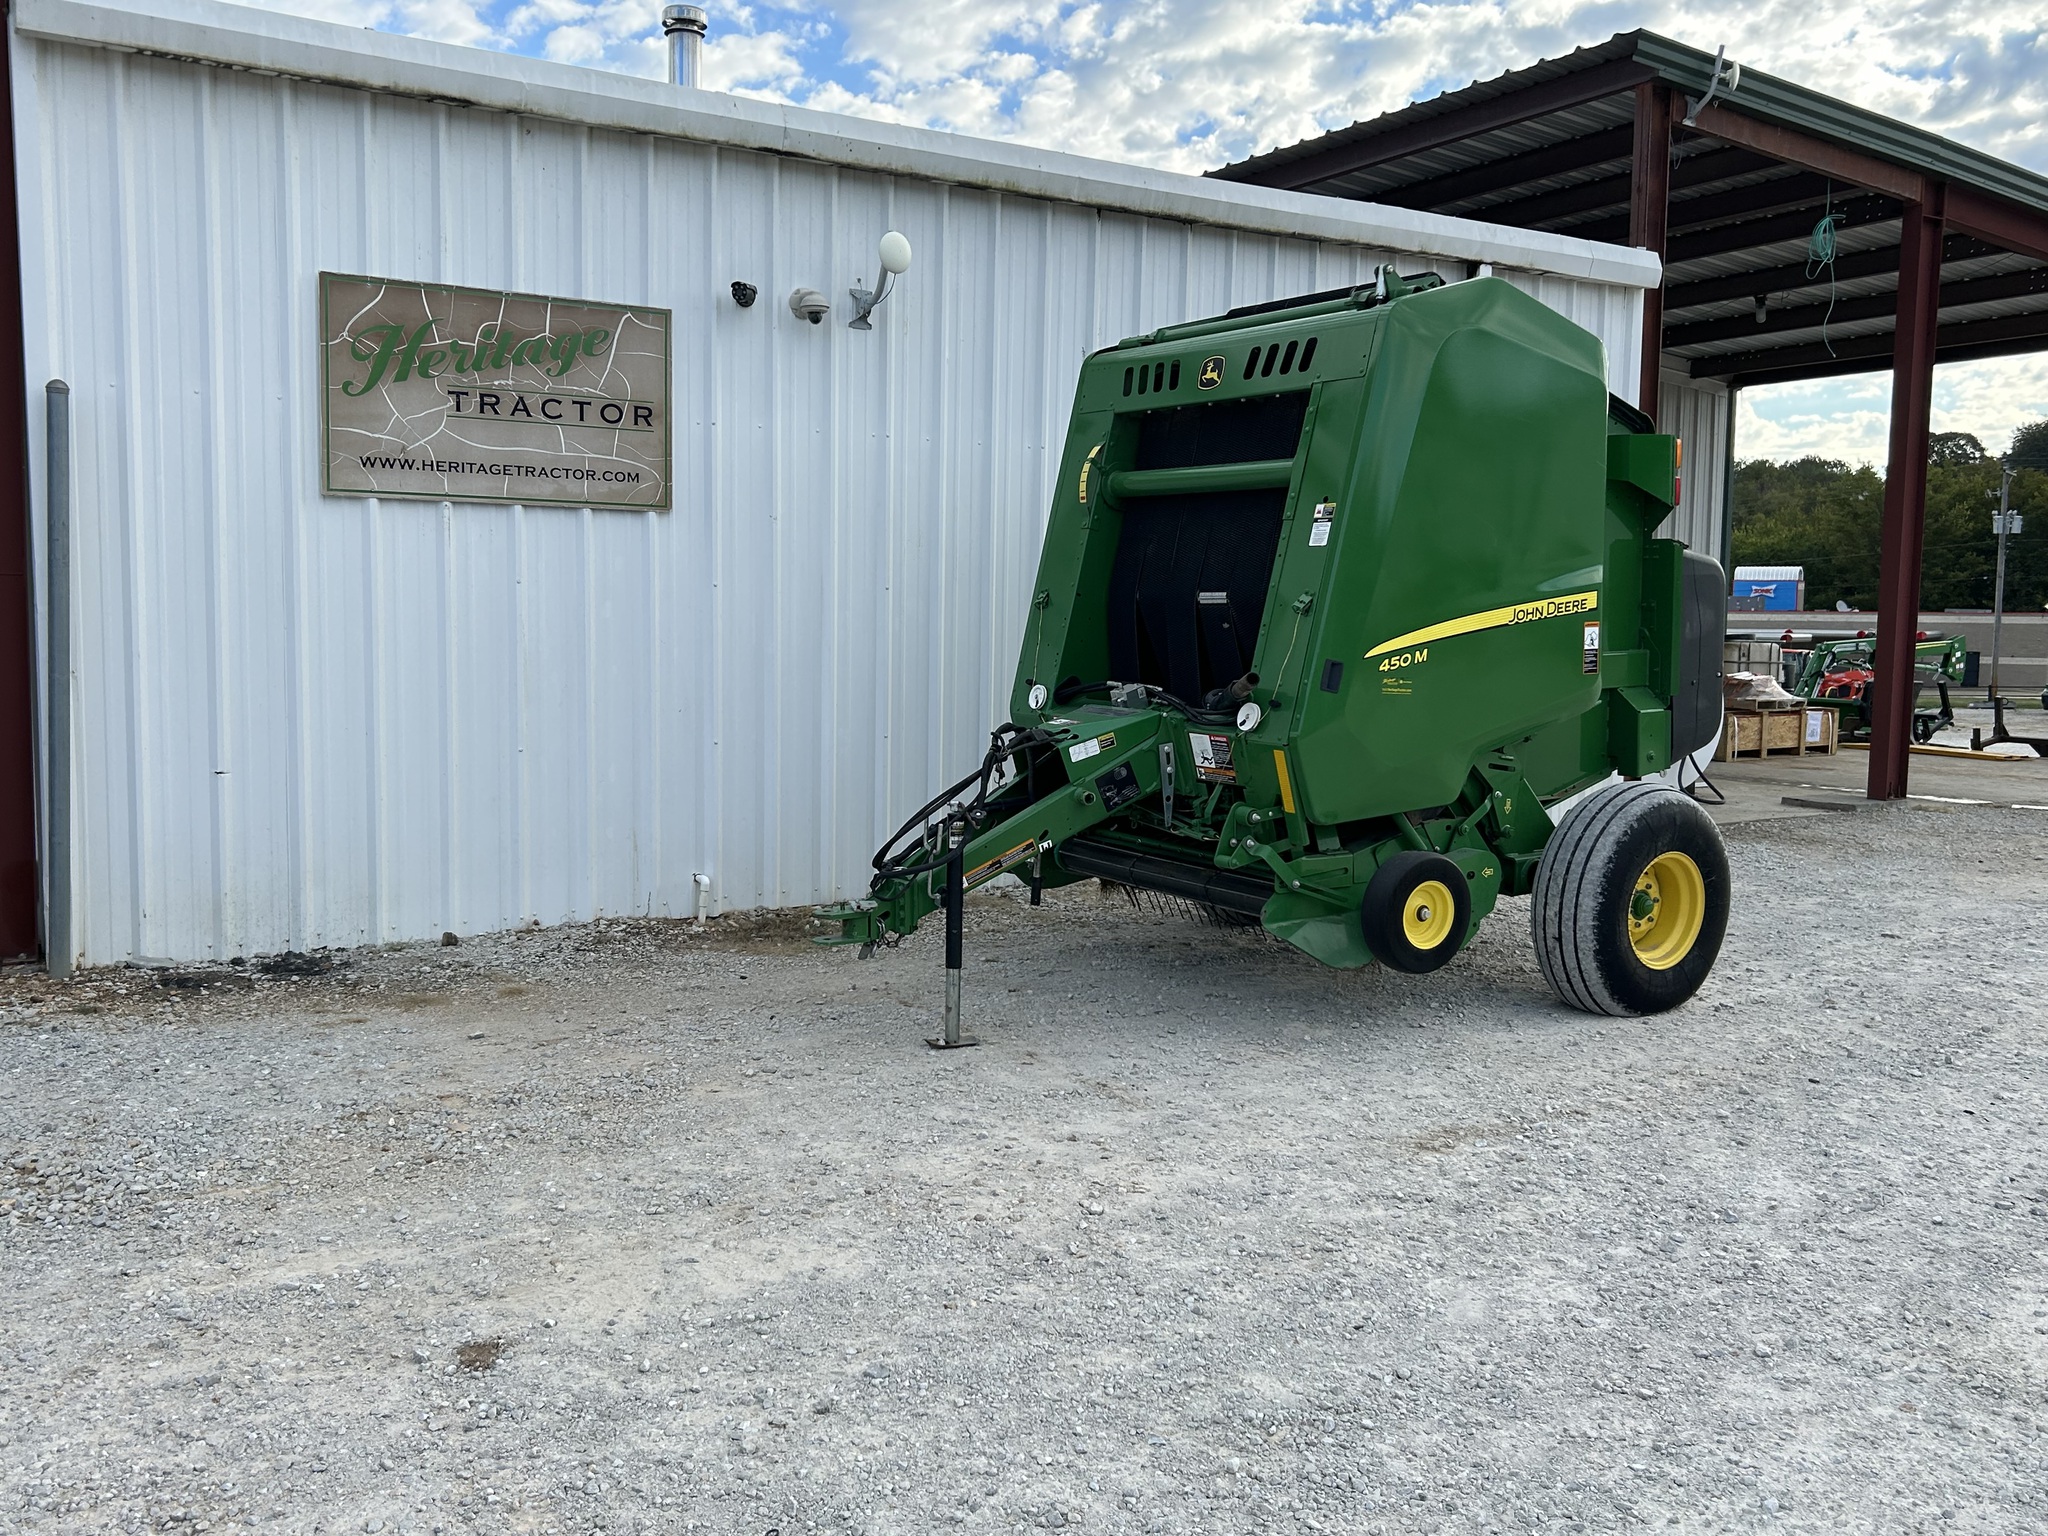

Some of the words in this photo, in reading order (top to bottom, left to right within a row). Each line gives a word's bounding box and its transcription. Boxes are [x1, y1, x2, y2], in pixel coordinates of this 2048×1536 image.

[341, 318, 610, 398] Heritage
[447, 389, 654, 428] TRACTOR
[358, 455, 640, 484] WWW.HERITAGETRACTOR.COM
[1508, 606, 1544, 623] JOHN
[1547, 598, 1588, 616] DEERE
[1378, 653, 1412, 672] 450
[1414, 648, 1428, 664] M
